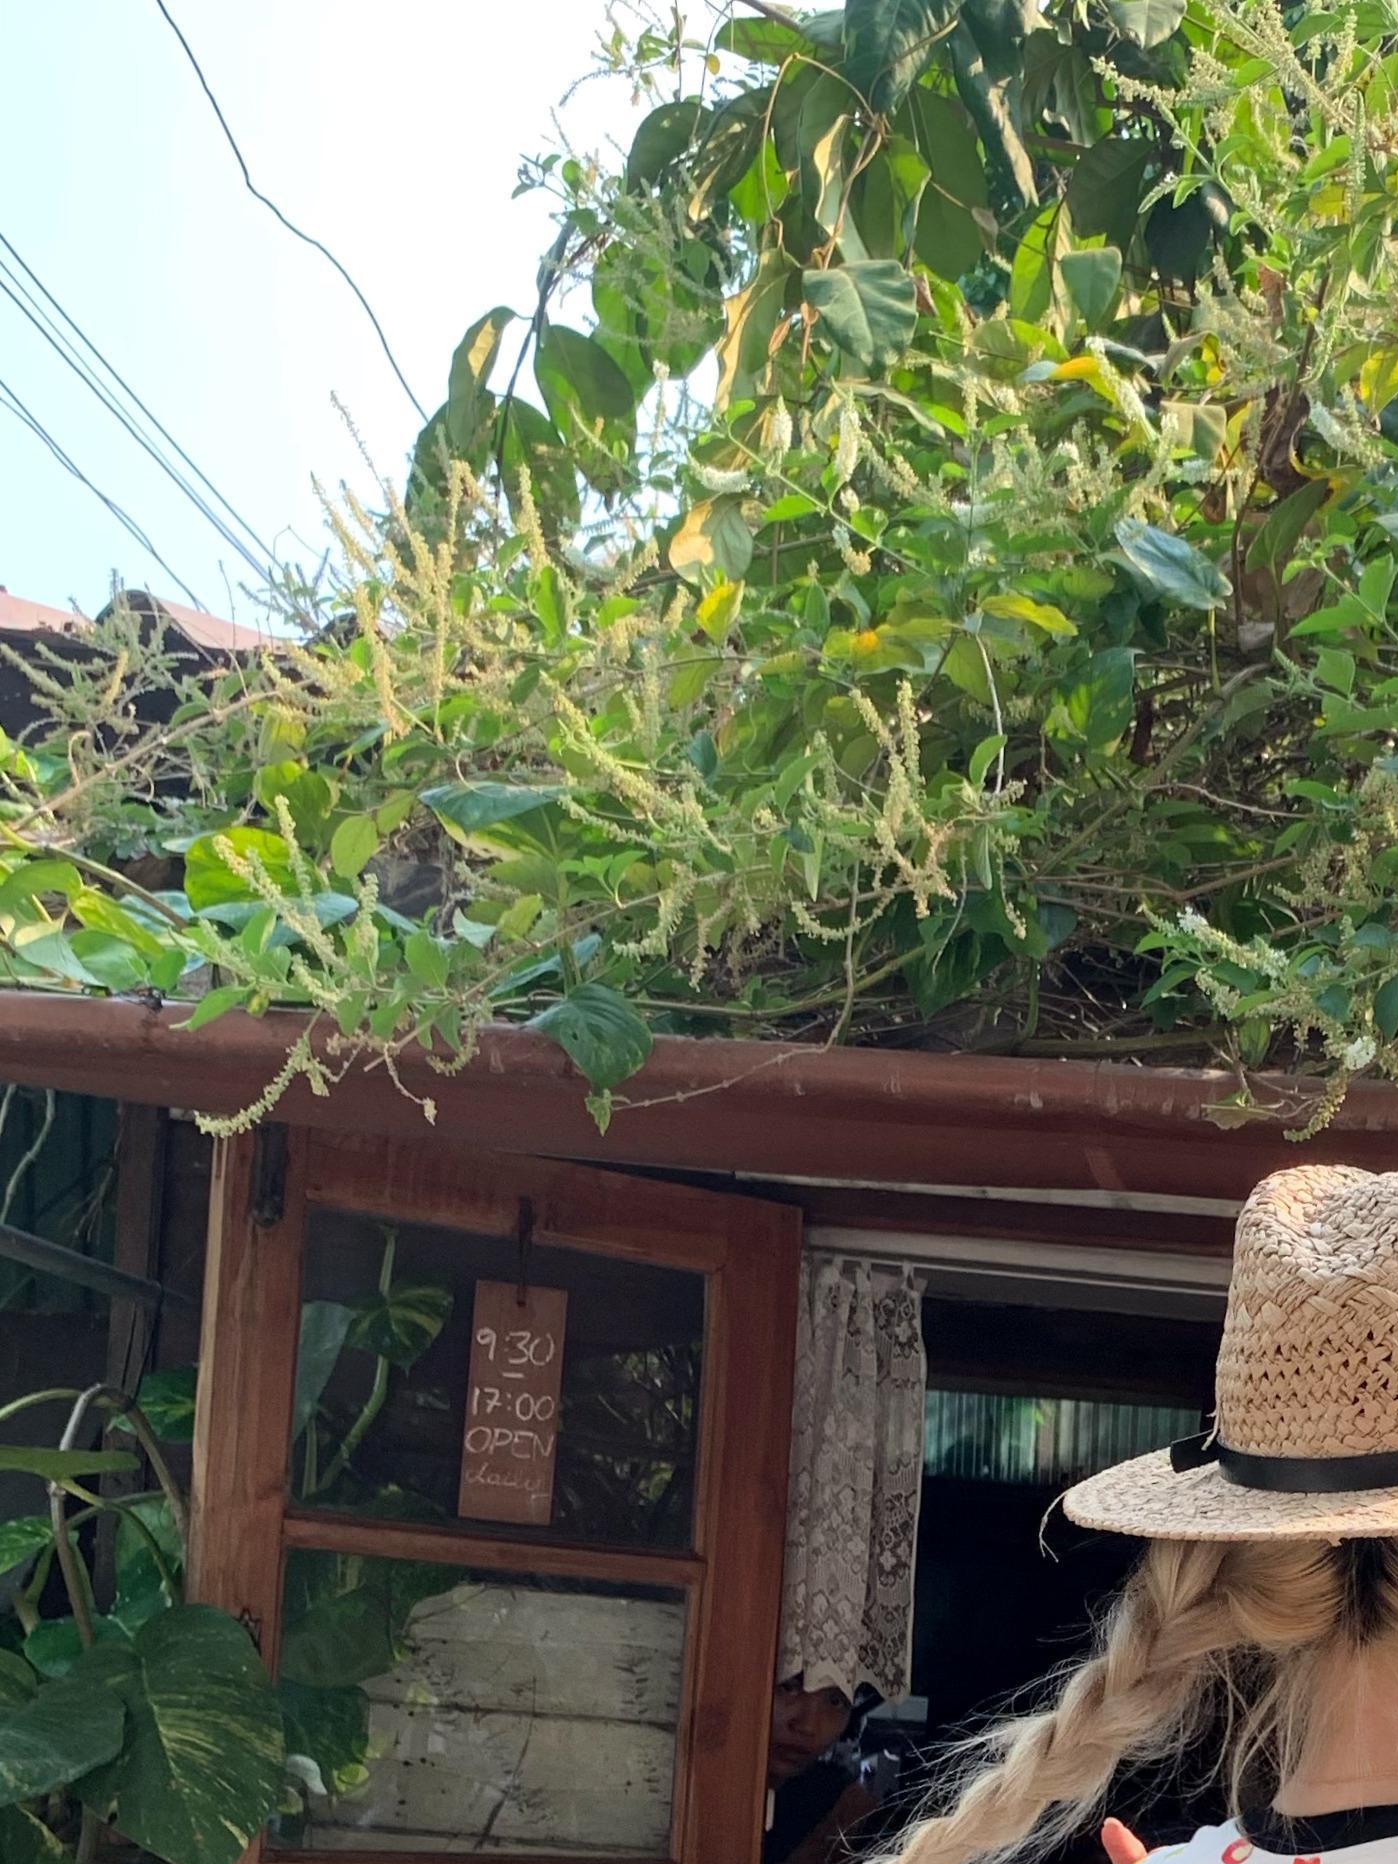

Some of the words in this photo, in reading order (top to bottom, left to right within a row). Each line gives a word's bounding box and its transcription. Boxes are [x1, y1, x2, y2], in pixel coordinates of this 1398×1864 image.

[477, 1327, 554, 1365] 9:30
[471, 1387, 554, 1420] 17:00
[464, 1427, 553, 1460] OPEN
